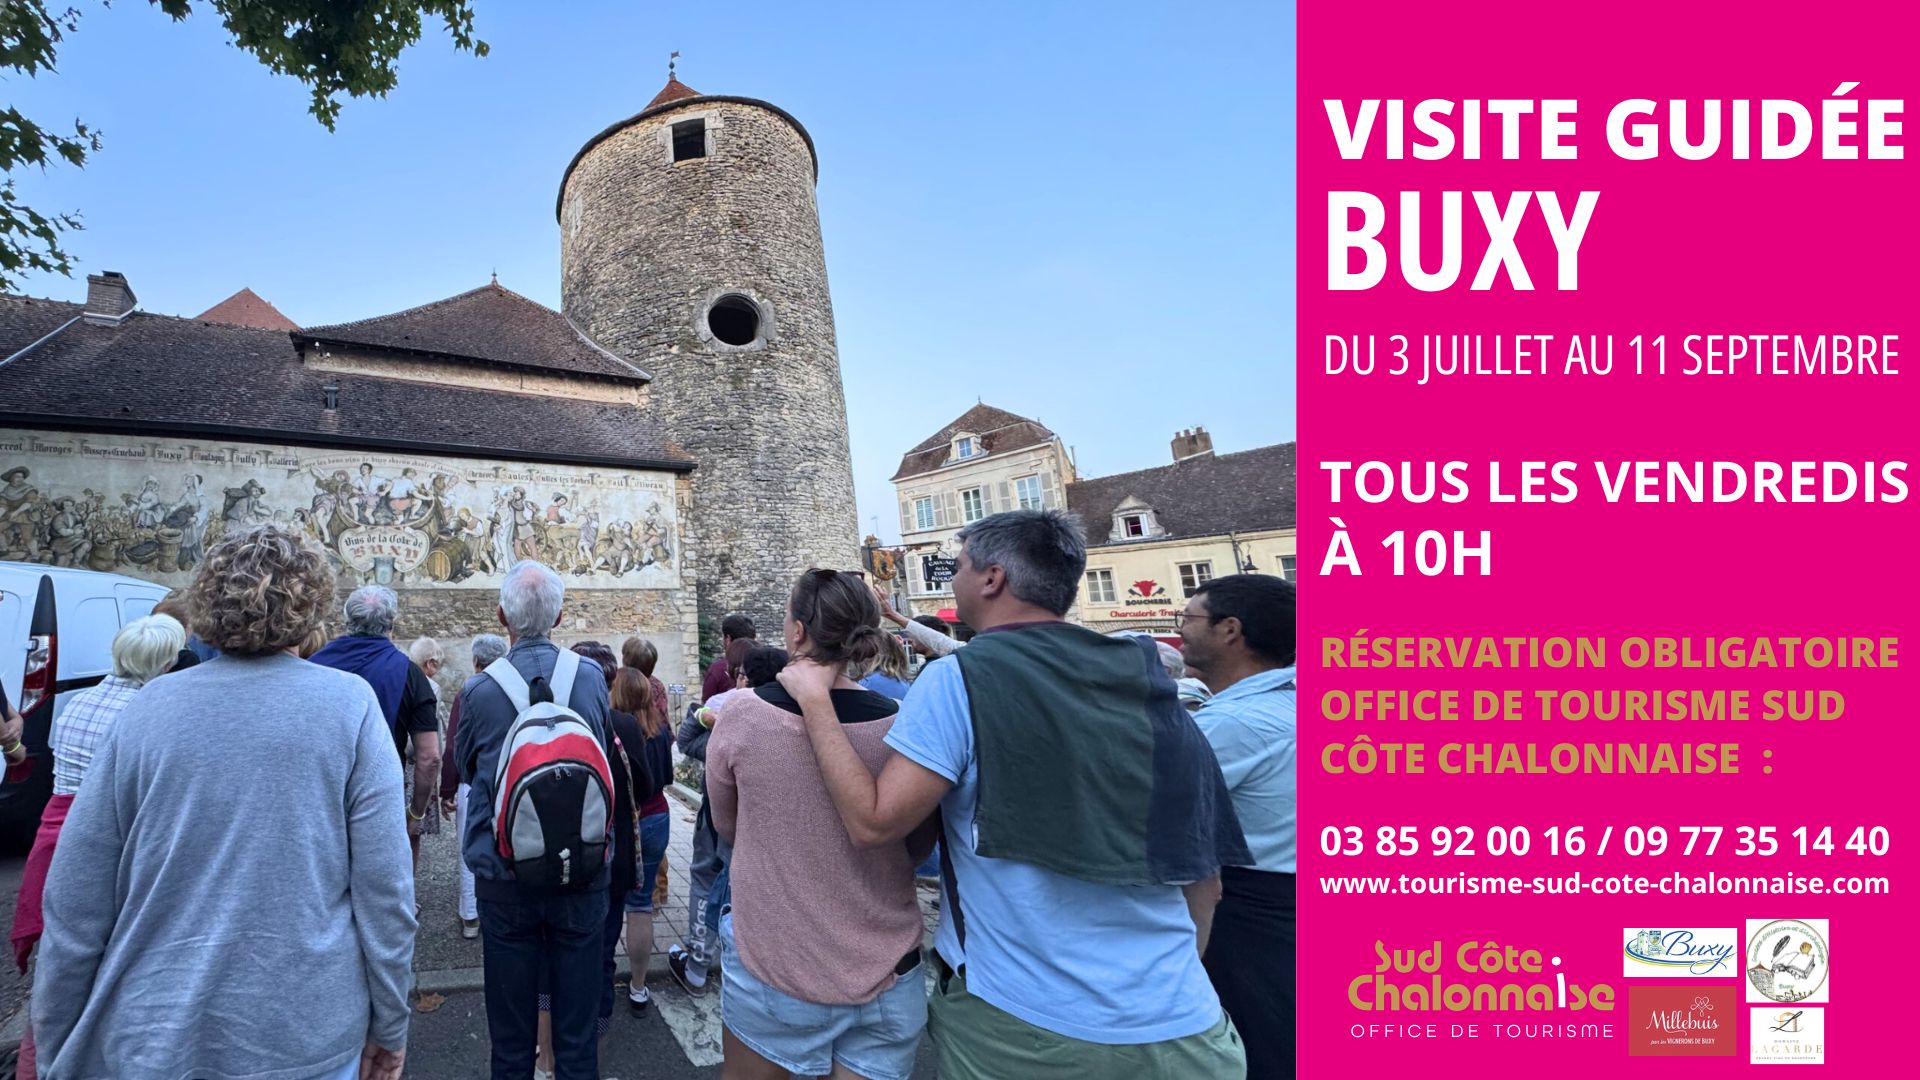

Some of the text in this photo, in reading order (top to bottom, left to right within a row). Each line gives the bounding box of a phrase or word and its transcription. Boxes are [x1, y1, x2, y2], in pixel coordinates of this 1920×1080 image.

[345, 536, 365, 546] Vins
[367, 534, 376, 543] de
[378, 533, 388, 543] la
[1125, 598, 1172, 606] BOUCHERIE
[1110, 609, 1157, 618] Charcuterie
